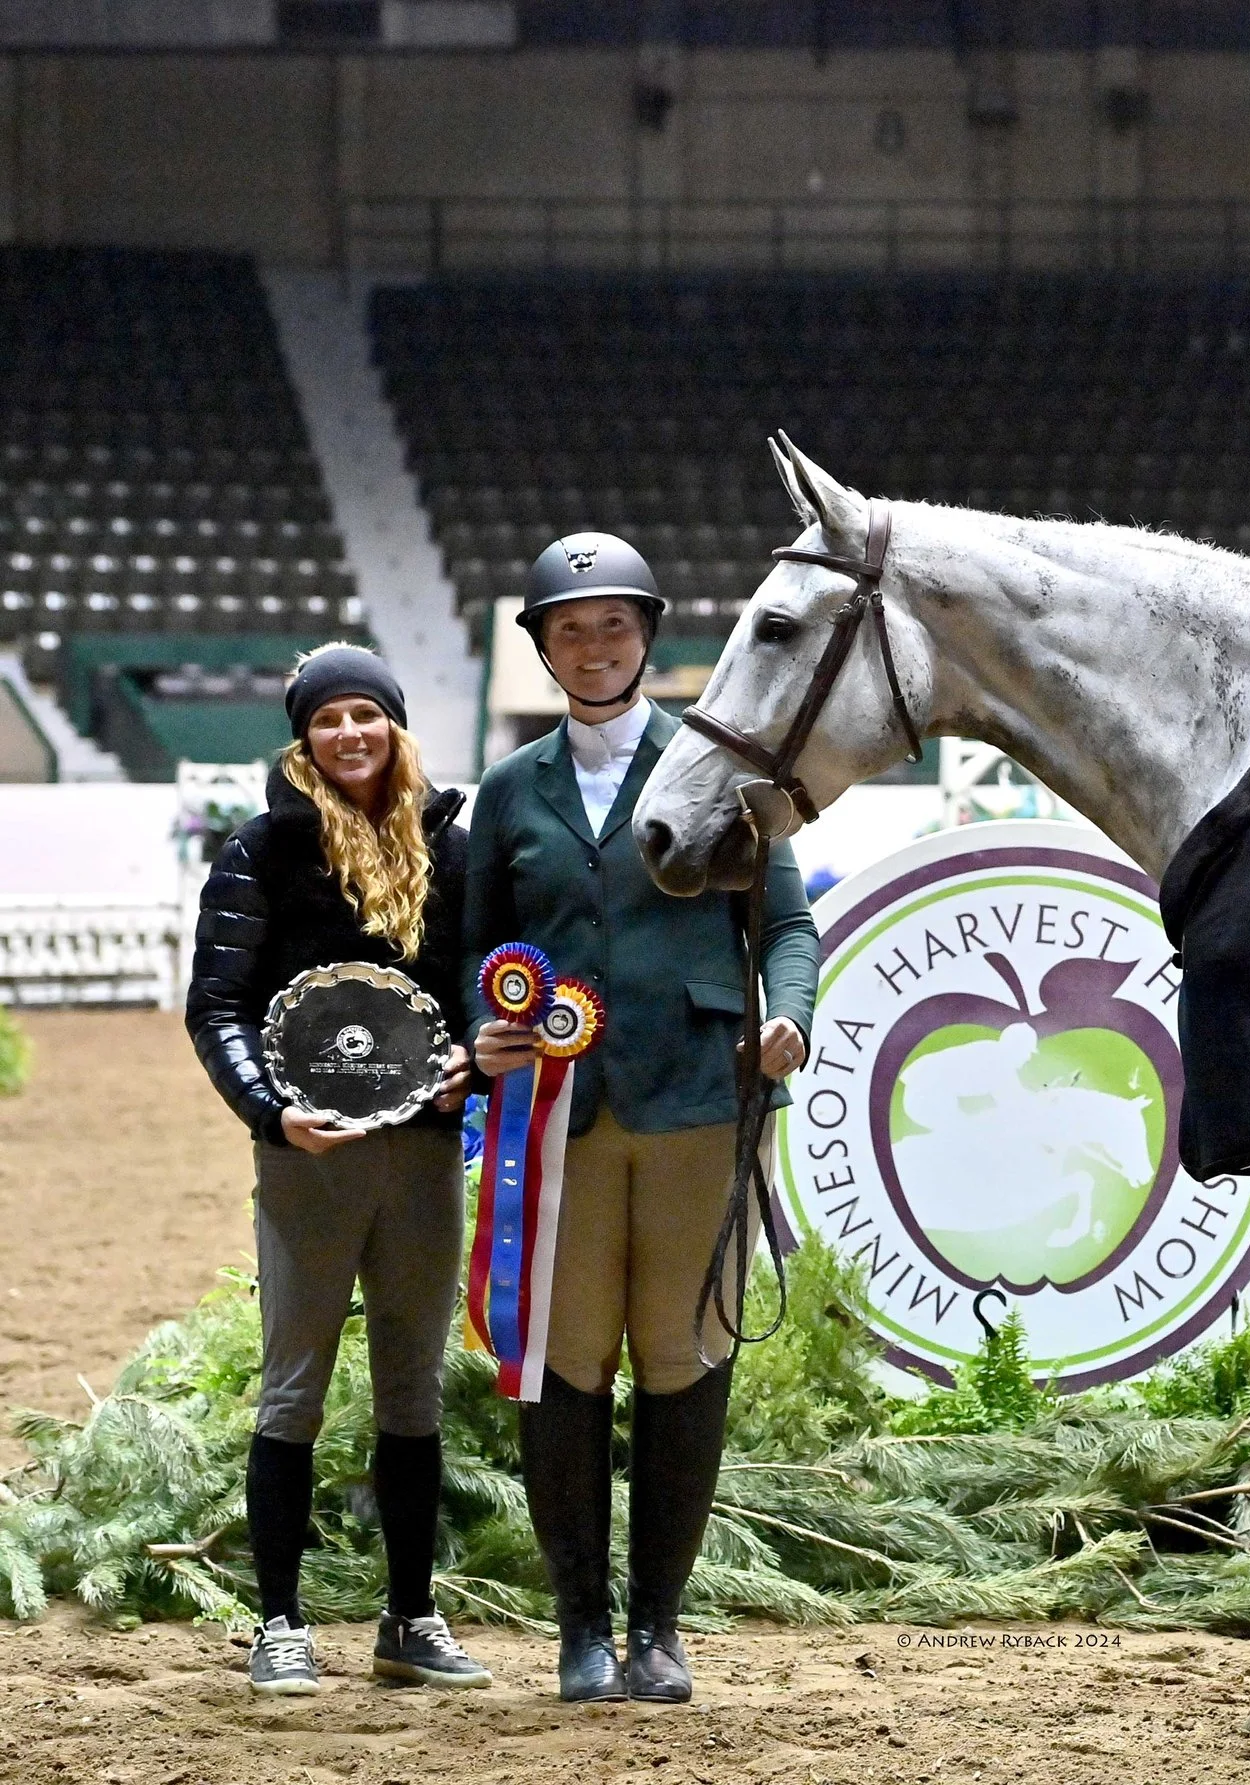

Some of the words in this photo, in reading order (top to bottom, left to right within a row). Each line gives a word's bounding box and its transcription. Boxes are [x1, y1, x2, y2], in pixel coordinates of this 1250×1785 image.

[874, 904, 1130, 995] HARVEST
[807, 1018, 960, 1326] MINNESOTA
[1113, 1177, 1238, 1323] SHOW
